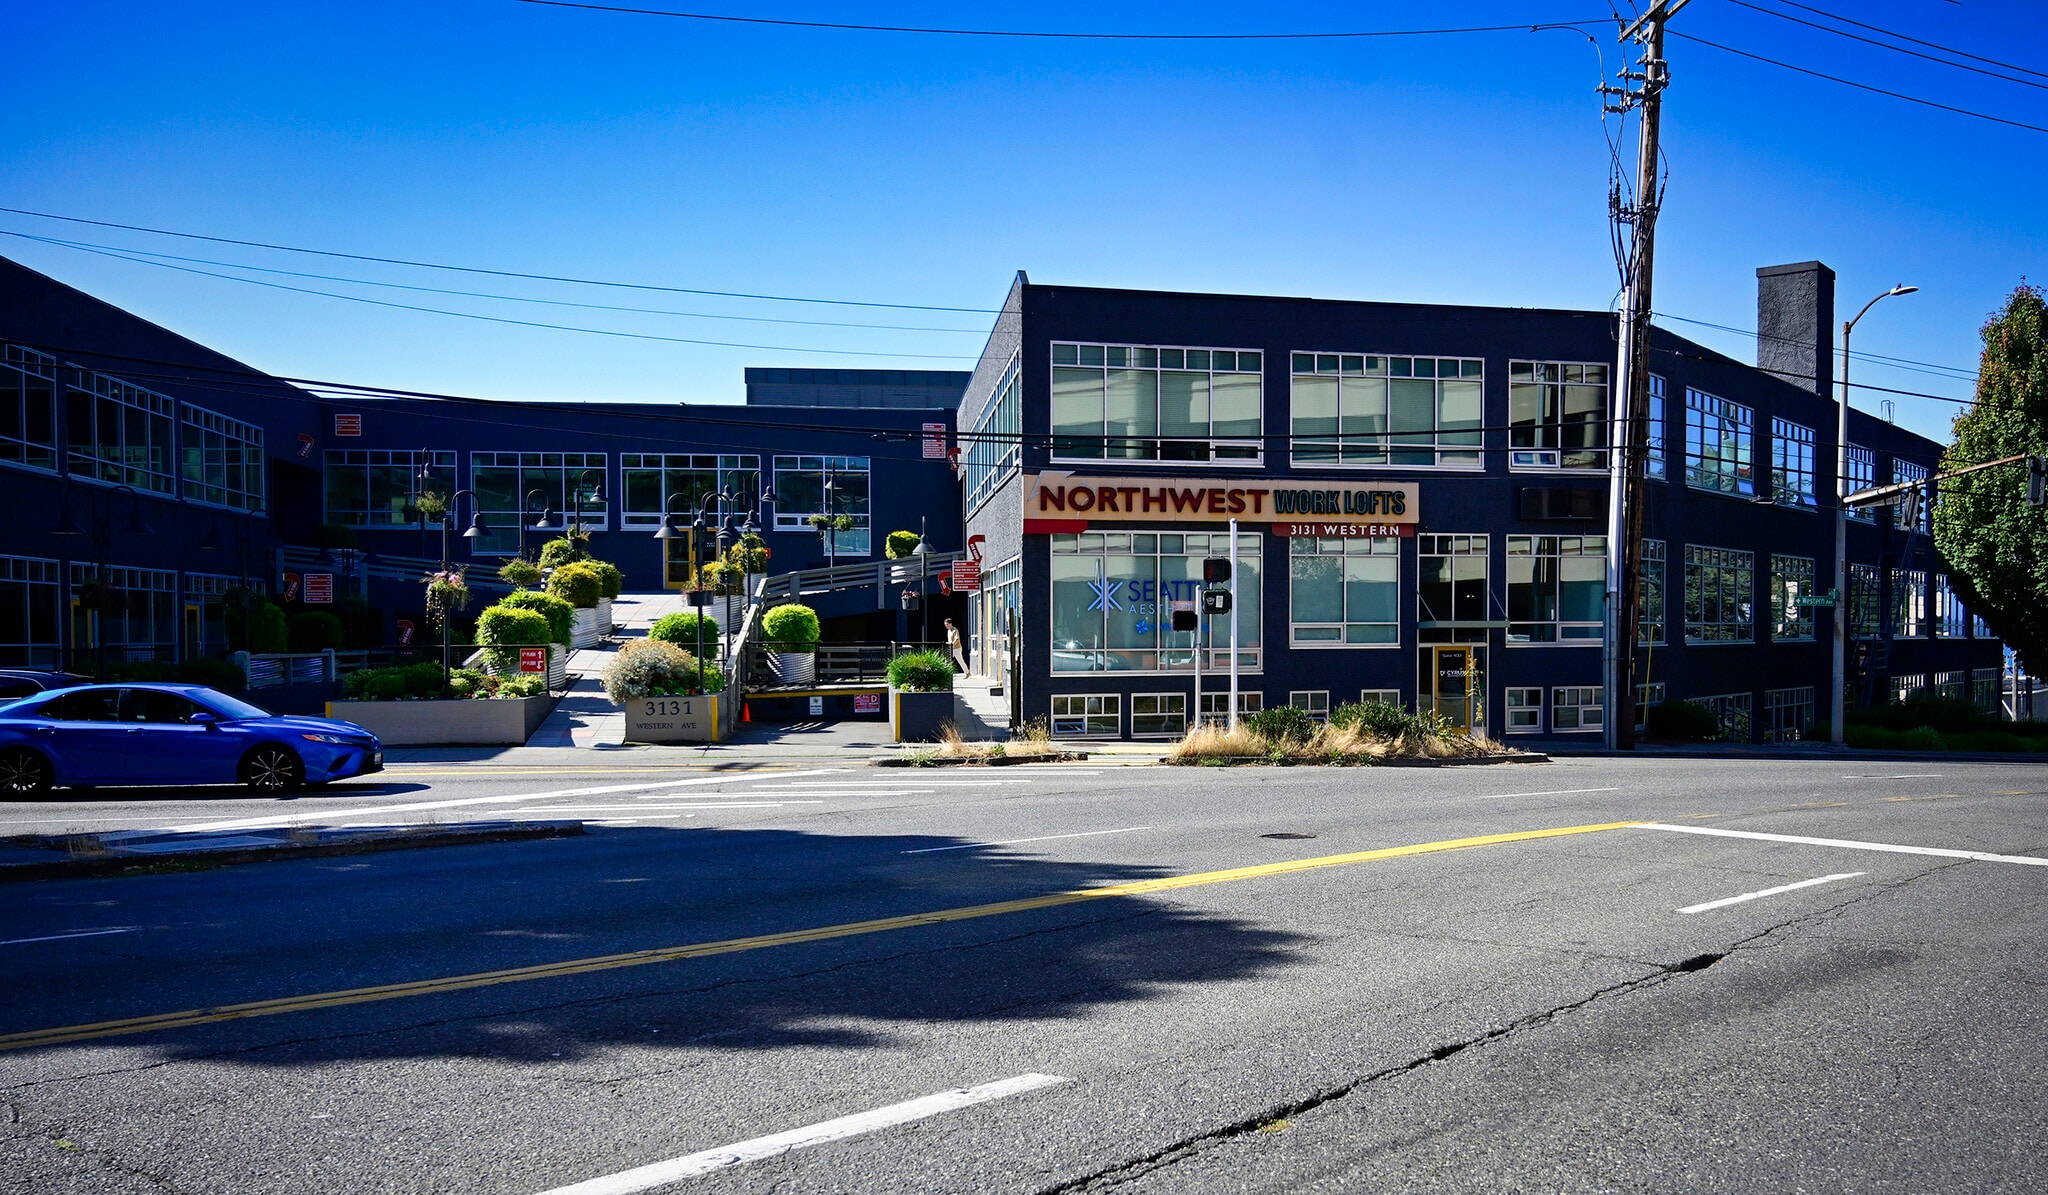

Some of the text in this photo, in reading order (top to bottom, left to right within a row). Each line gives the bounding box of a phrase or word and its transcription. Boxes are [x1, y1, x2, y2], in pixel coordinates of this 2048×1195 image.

[1040, 485, 1406, 516] NORTHWEST WORK LOFTS
[1290, 524, 1400, 536] 3131 WESTERN
[1127, 580, 1217, 603] SEATT
[1802, 597, 1825, 605] Western
[645, 701, 693, 716] 3131
[636, 722, 697, 730] WESTERN AVE
